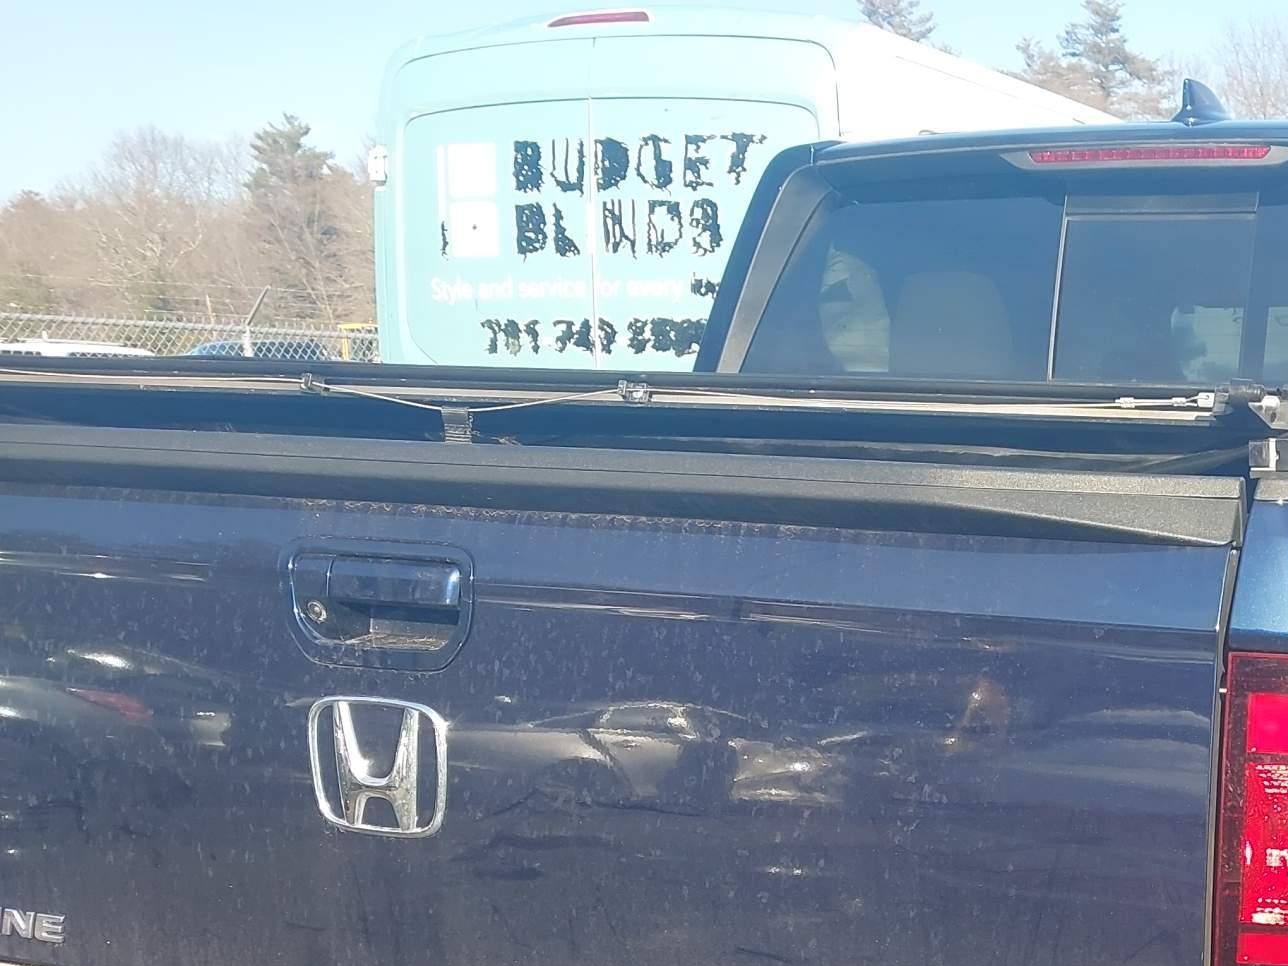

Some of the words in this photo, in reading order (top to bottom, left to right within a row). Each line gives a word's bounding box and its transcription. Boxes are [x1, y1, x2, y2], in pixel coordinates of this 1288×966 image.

[512, 131, 768, 196] BUDGET
[514, 197, 724, 262] BLNDS
[479, 274, 513, 299] and
